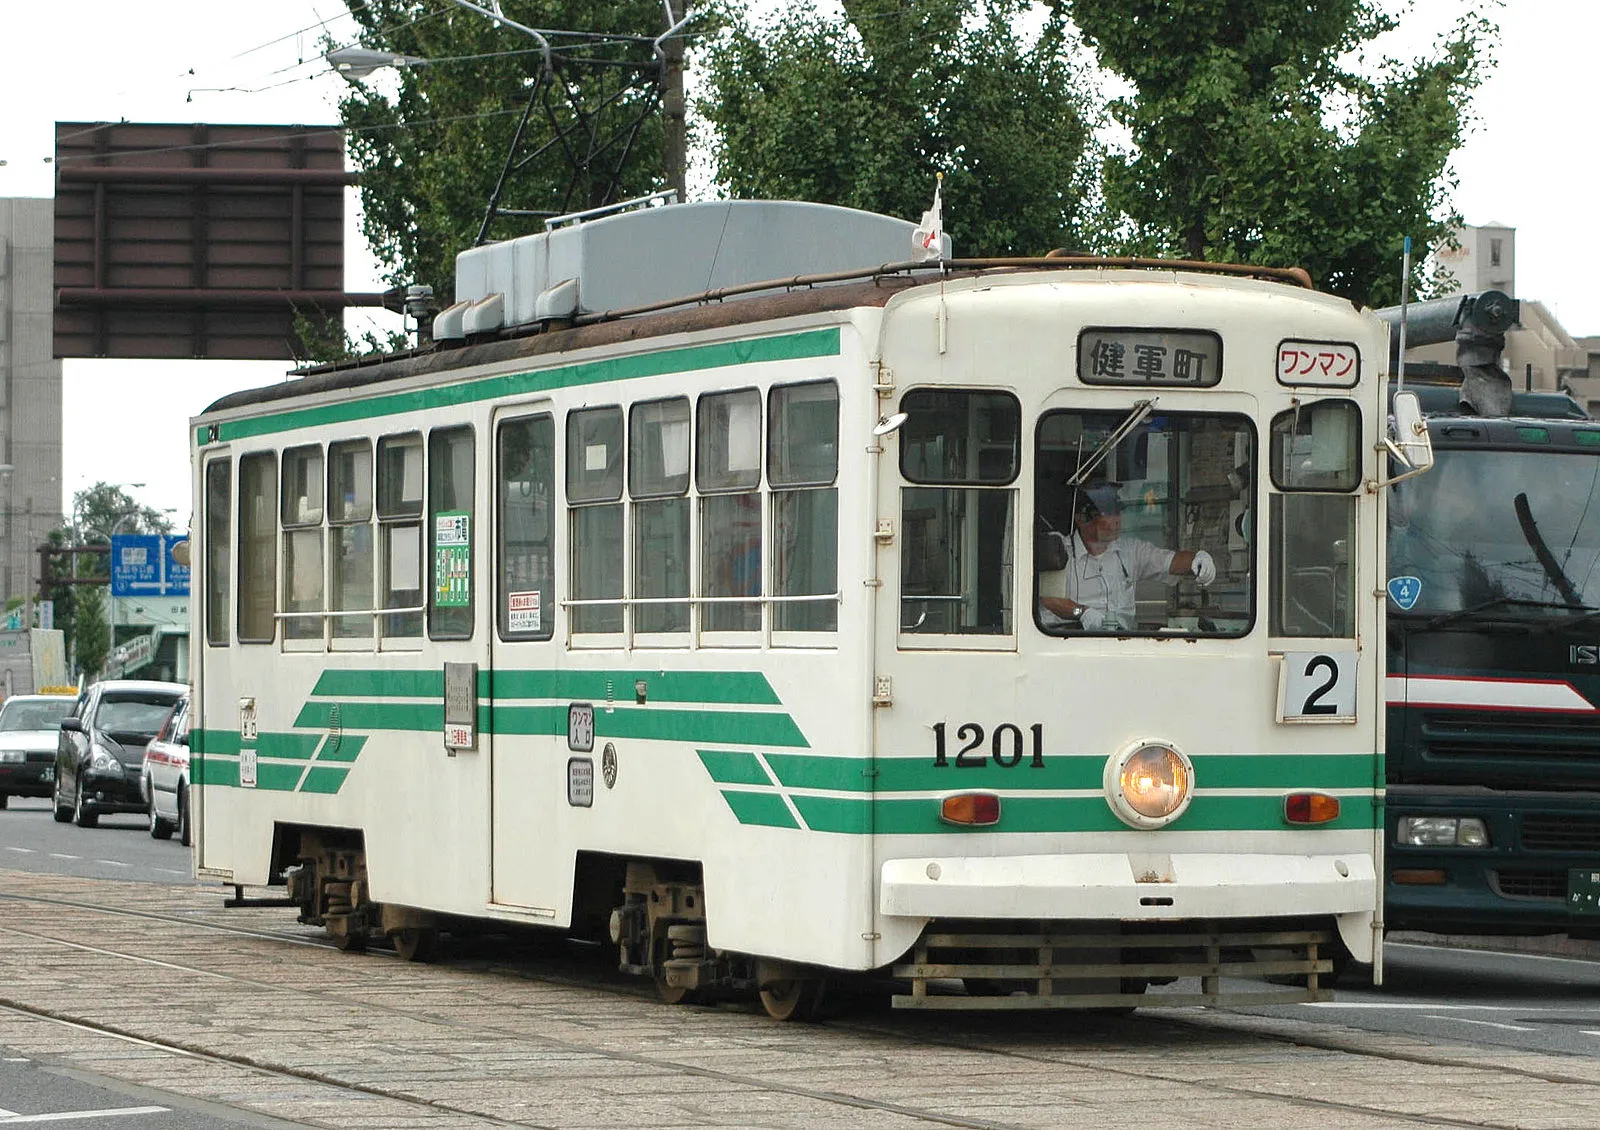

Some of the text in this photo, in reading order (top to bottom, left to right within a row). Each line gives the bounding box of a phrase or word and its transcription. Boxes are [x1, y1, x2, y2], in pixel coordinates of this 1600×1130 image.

[1090, 339, 1208, 381] 健軍町
[1281, 350, 1353, 377] ワンマン
[1400, 585, 1410, 598] 4
[1569, 645, 1600, 664] IS
[1301, 654, 1340, 715] 2
[572, 711, 592, 726] ワンマン
[932, 722, 1046, 768] 1201
